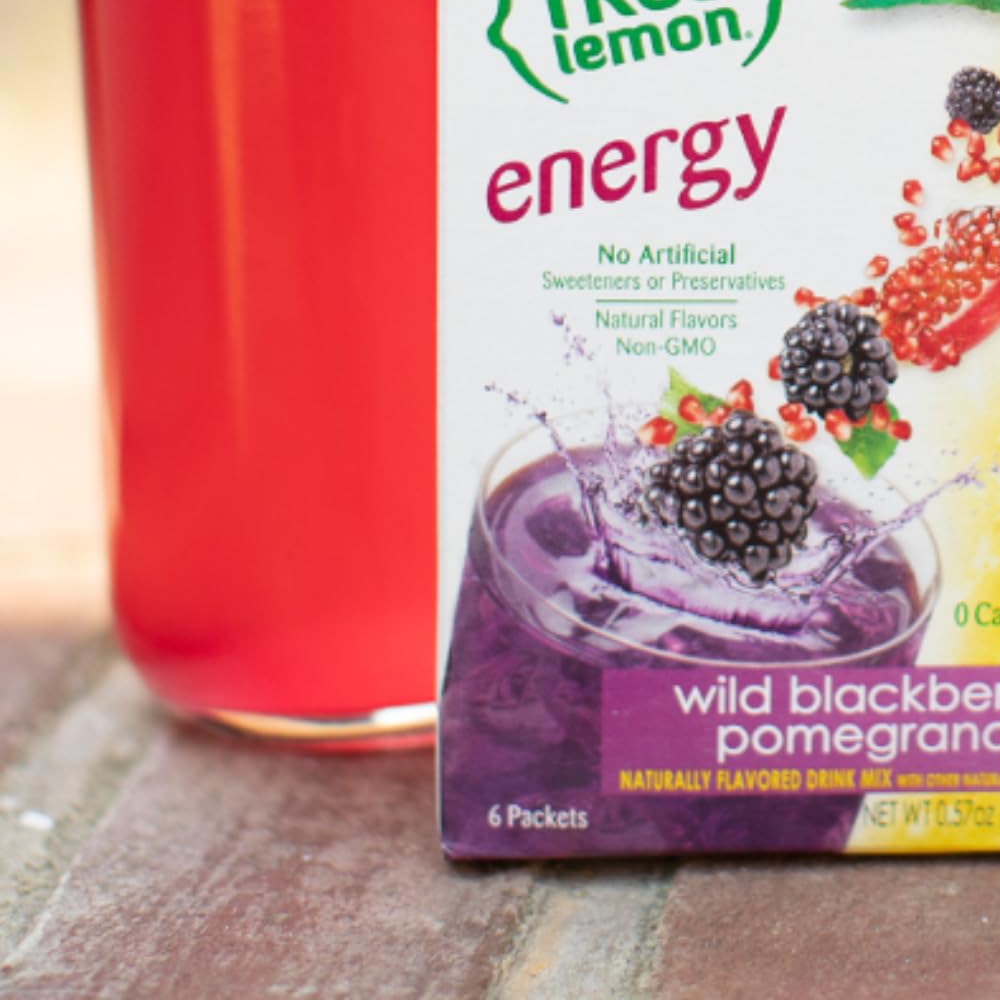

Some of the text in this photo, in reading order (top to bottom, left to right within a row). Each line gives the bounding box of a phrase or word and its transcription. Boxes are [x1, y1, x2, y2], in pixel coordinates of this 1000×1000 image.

[552, 1, 743, 76] lemon
[486, 105, 788, 225] energy
[597, 242, 736, 265] No Artificial
[541, 270, 786, 291] Sweeteners or Preservatives
[595, 308, 738, 330] Natural Flavors
[615, 336, 717, 357] Non-GMO
[953, 600, 969, 628] 0
[673, 675, 773, 716] wild
[619, 768, 710, 791] NATURALLY
[716, 768, 801, 791] FLAVORED
[806, 768, 856, 790] DRINK
[860, 768, 893, 789] MIX
[487, 803, 589, 829] 6 Packets
[862, 800, 898, 828] NET
[903, 800, 931, 828] WT
[934, 799, 996, 828] 0.57oz
